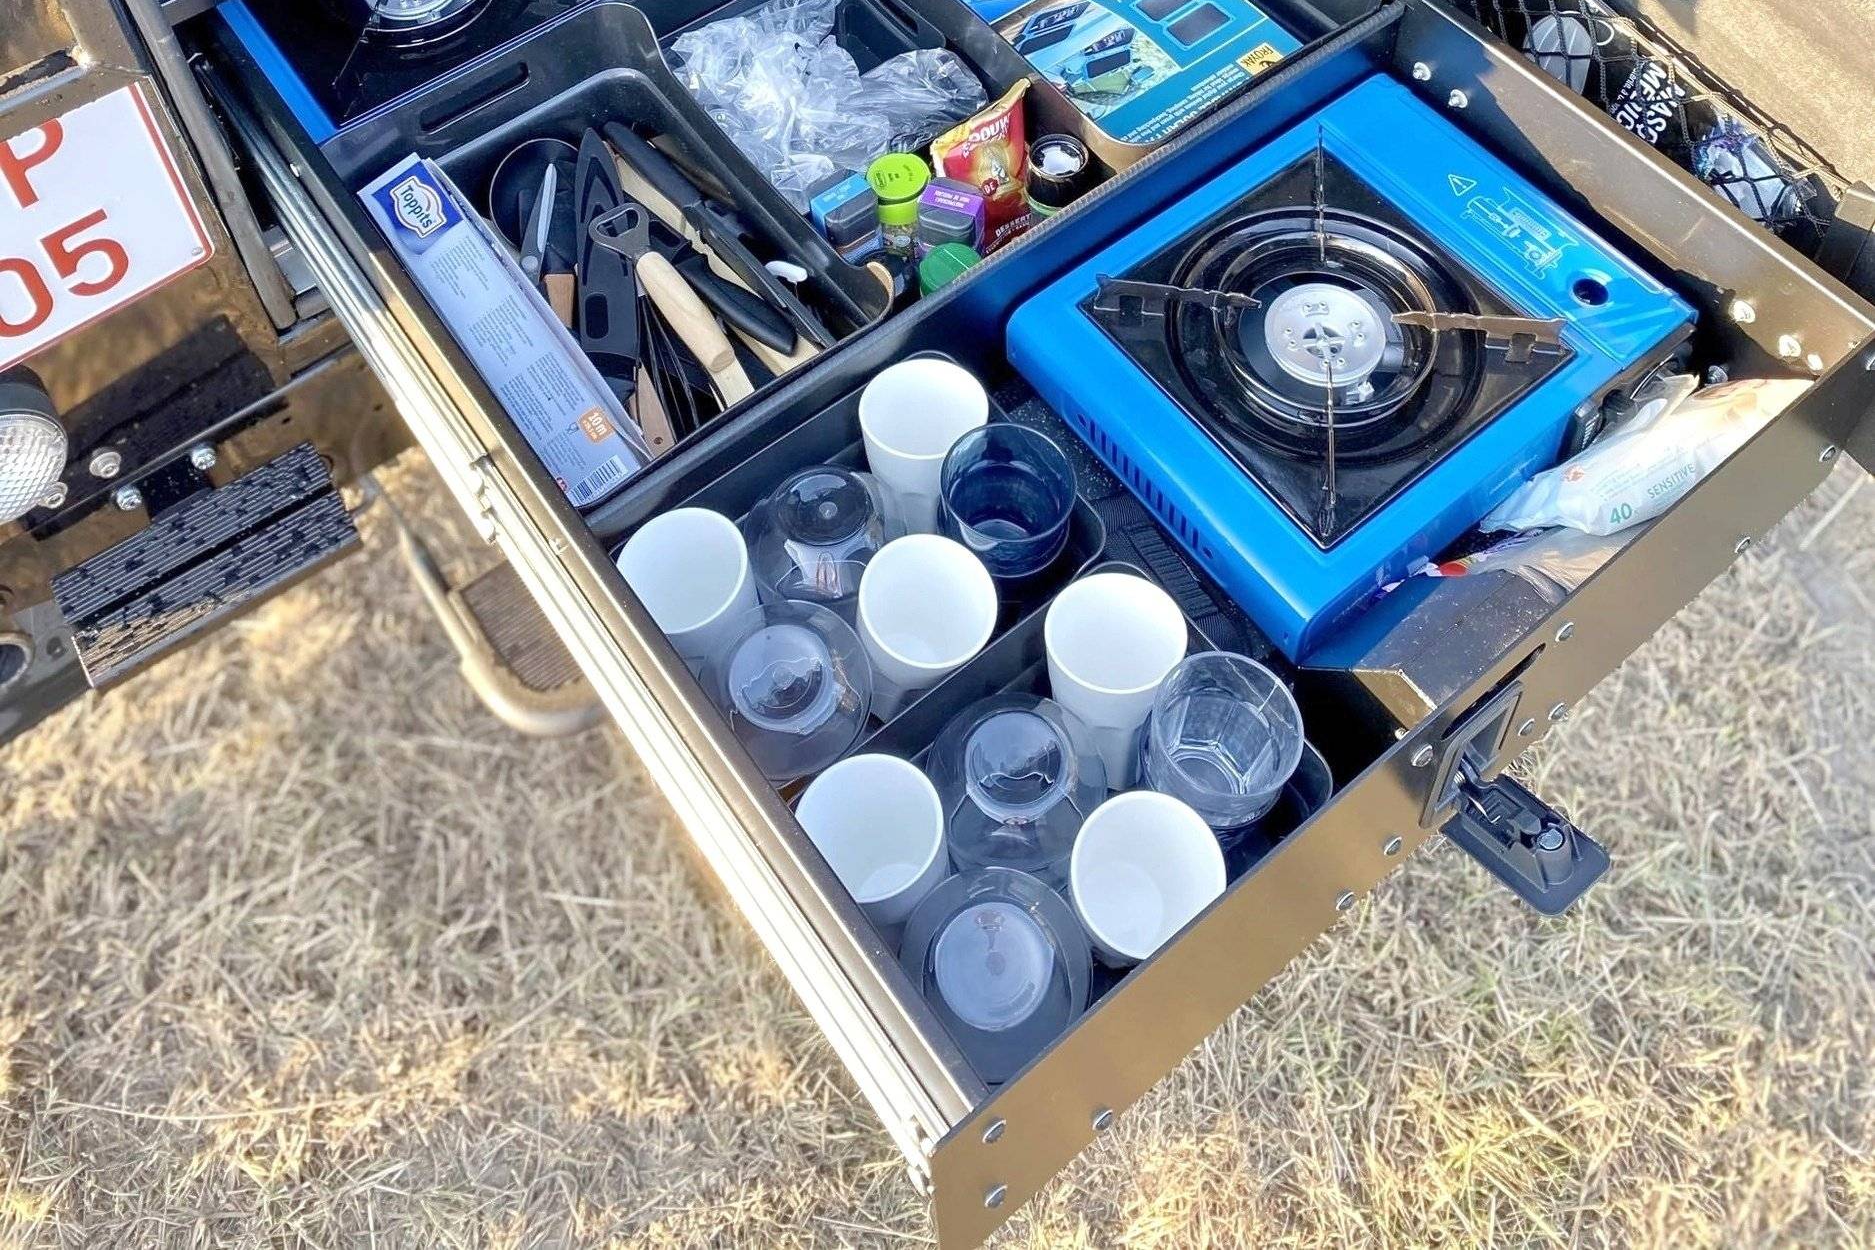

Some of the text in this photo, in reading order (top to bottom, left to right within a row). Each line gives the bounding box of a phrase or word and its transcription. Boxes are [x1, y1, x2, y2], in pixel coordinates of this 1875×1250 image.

[400, 184, 433, 229] Toppits
[1646, 463, 1696, 500] SENSITIVE
[1609, 502, 1633, 524] 40
